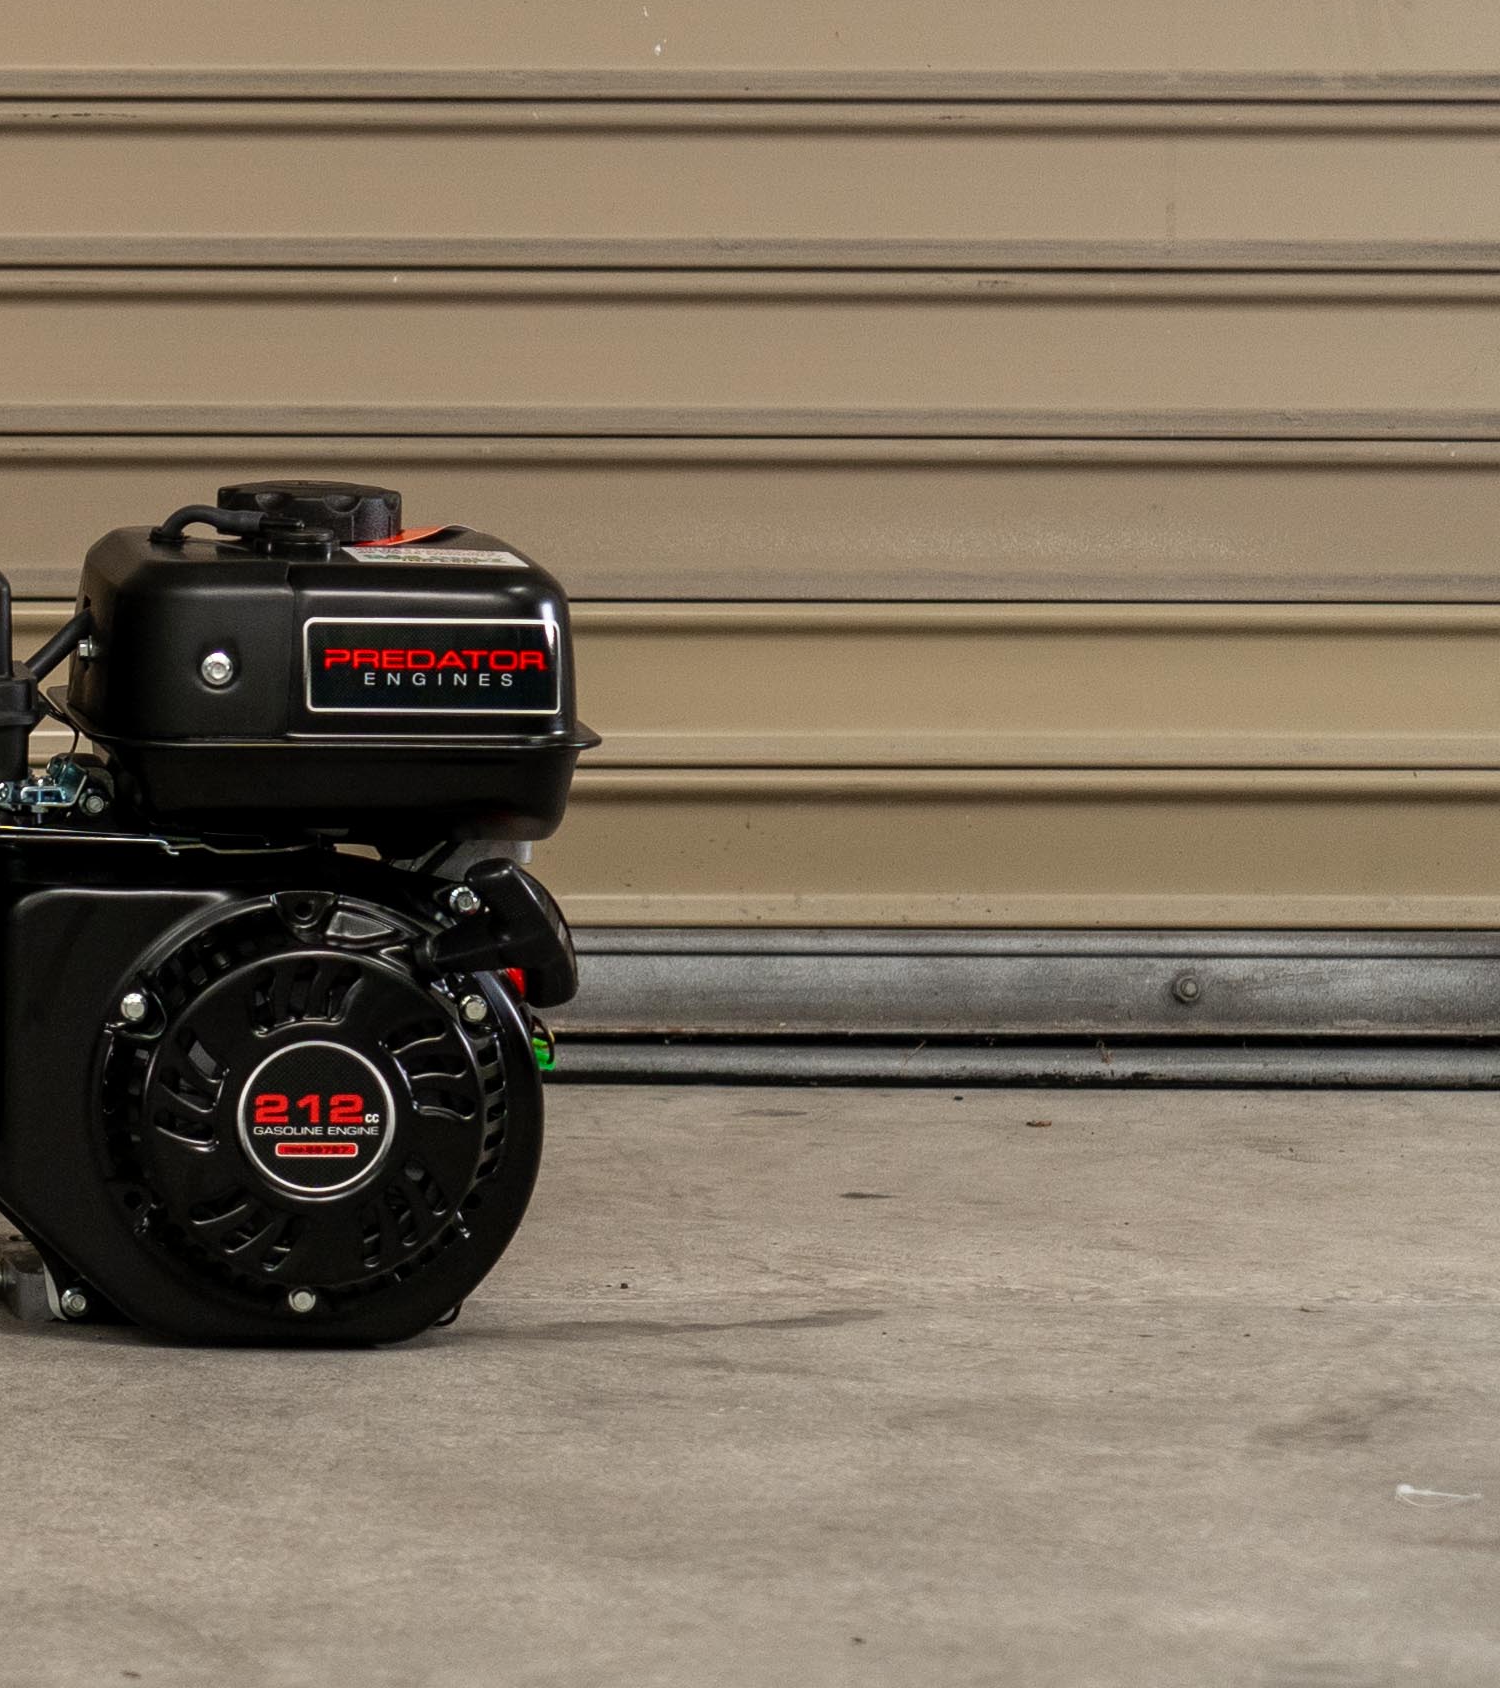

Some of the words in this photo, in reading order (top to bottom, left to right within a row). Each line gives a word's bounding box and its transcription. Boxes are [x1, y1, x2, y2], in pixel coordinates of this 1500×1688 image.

[323, 648, 549, 671] PREDATOR
[364, 672, 514, 687] ENGINES
[253, 1125, 324, 1136] GASOLINE
[327, 1125, 380, 1136] ENGINE
